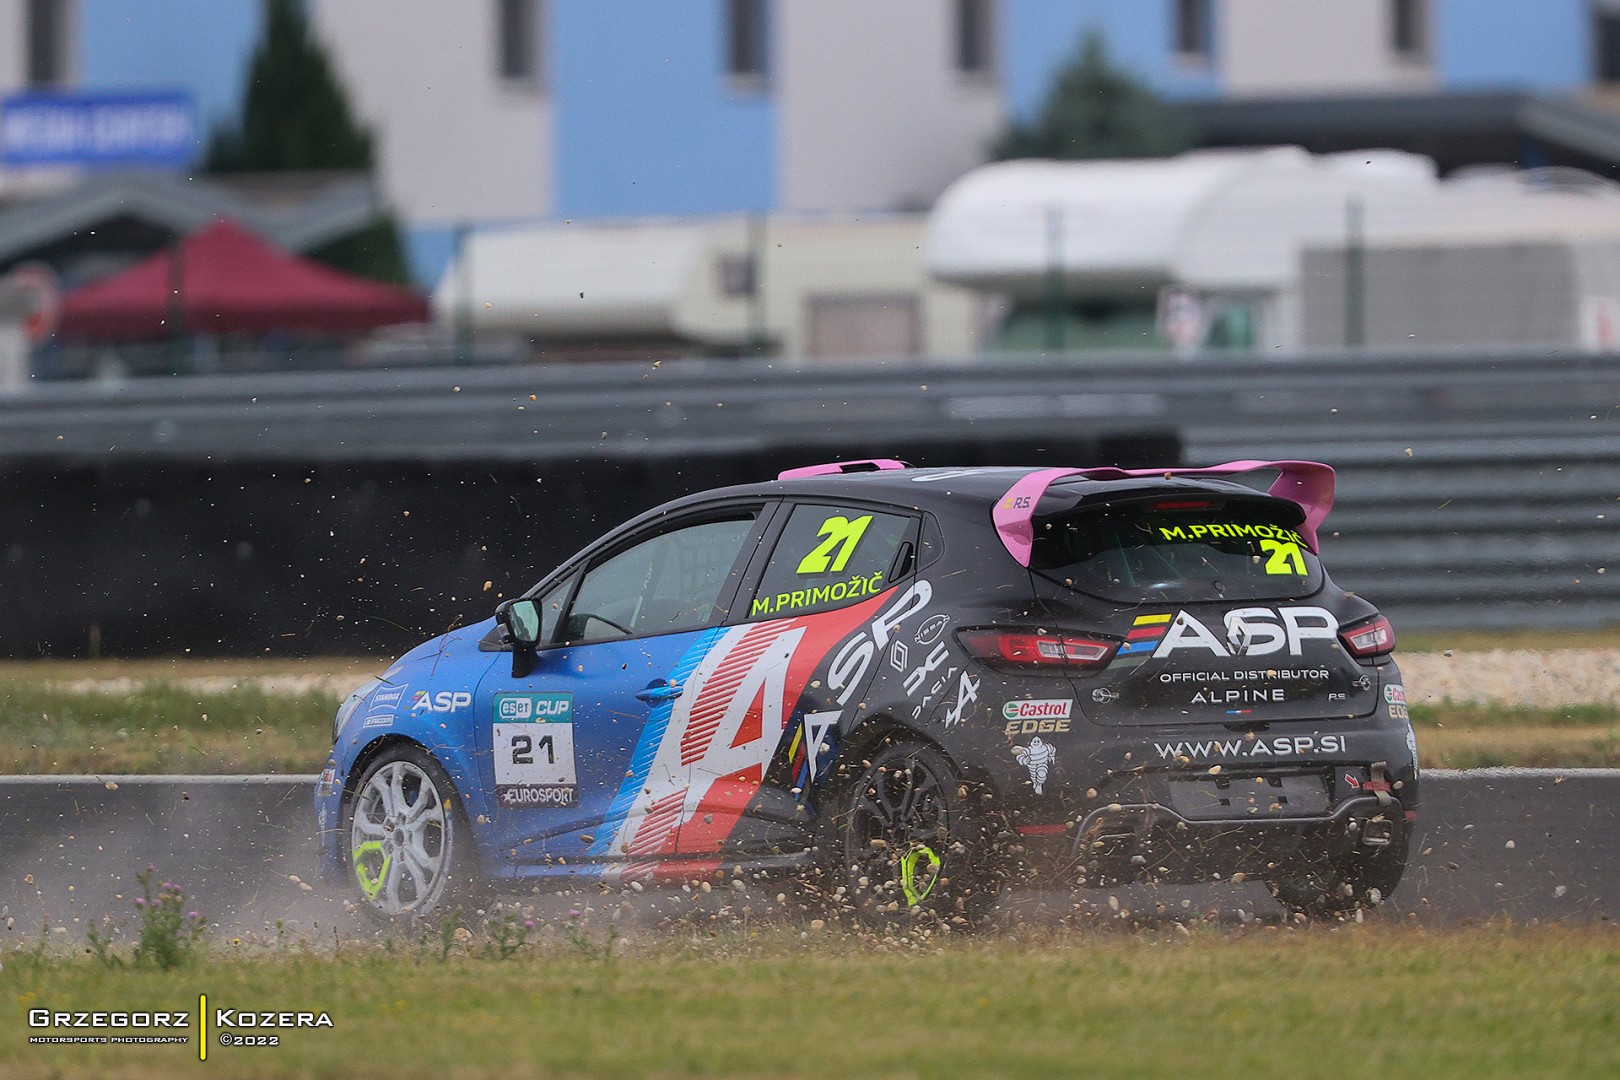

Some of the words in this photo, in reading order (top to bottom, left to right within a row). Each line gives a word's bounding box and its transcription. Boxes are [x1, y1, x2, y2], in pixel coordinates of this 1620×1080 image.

[796, 515, 873, 574] 21
[1158, 523, 1308, 548] M.PRIMOŽIČ
[1259, 539, 1309, 576] 21
[751, 571, 884, 616] M.PRIMOŽIČ
[914, 614, 951, 645] NISSAN
[1151, 606, 1340, 659] ASP
[1159, 671, 1231, 684] OFFICIAL
[1233, 668, 1330, 681] DISTRIBUTOR
[411, 691, 472, 713] ASP
[535, 700, 570, 715] CUP
[1190, 688, 1286, 705] ALPINE
[1019, 702, 1067, 717] Castrol
[1004, 718, 1072, 735] EDGE
[511, 734, 555, 765] 21
[1153, 735, 1348, 760] WWW.ASP.SI
[506, 787, 574, 803] EUROSPORT
